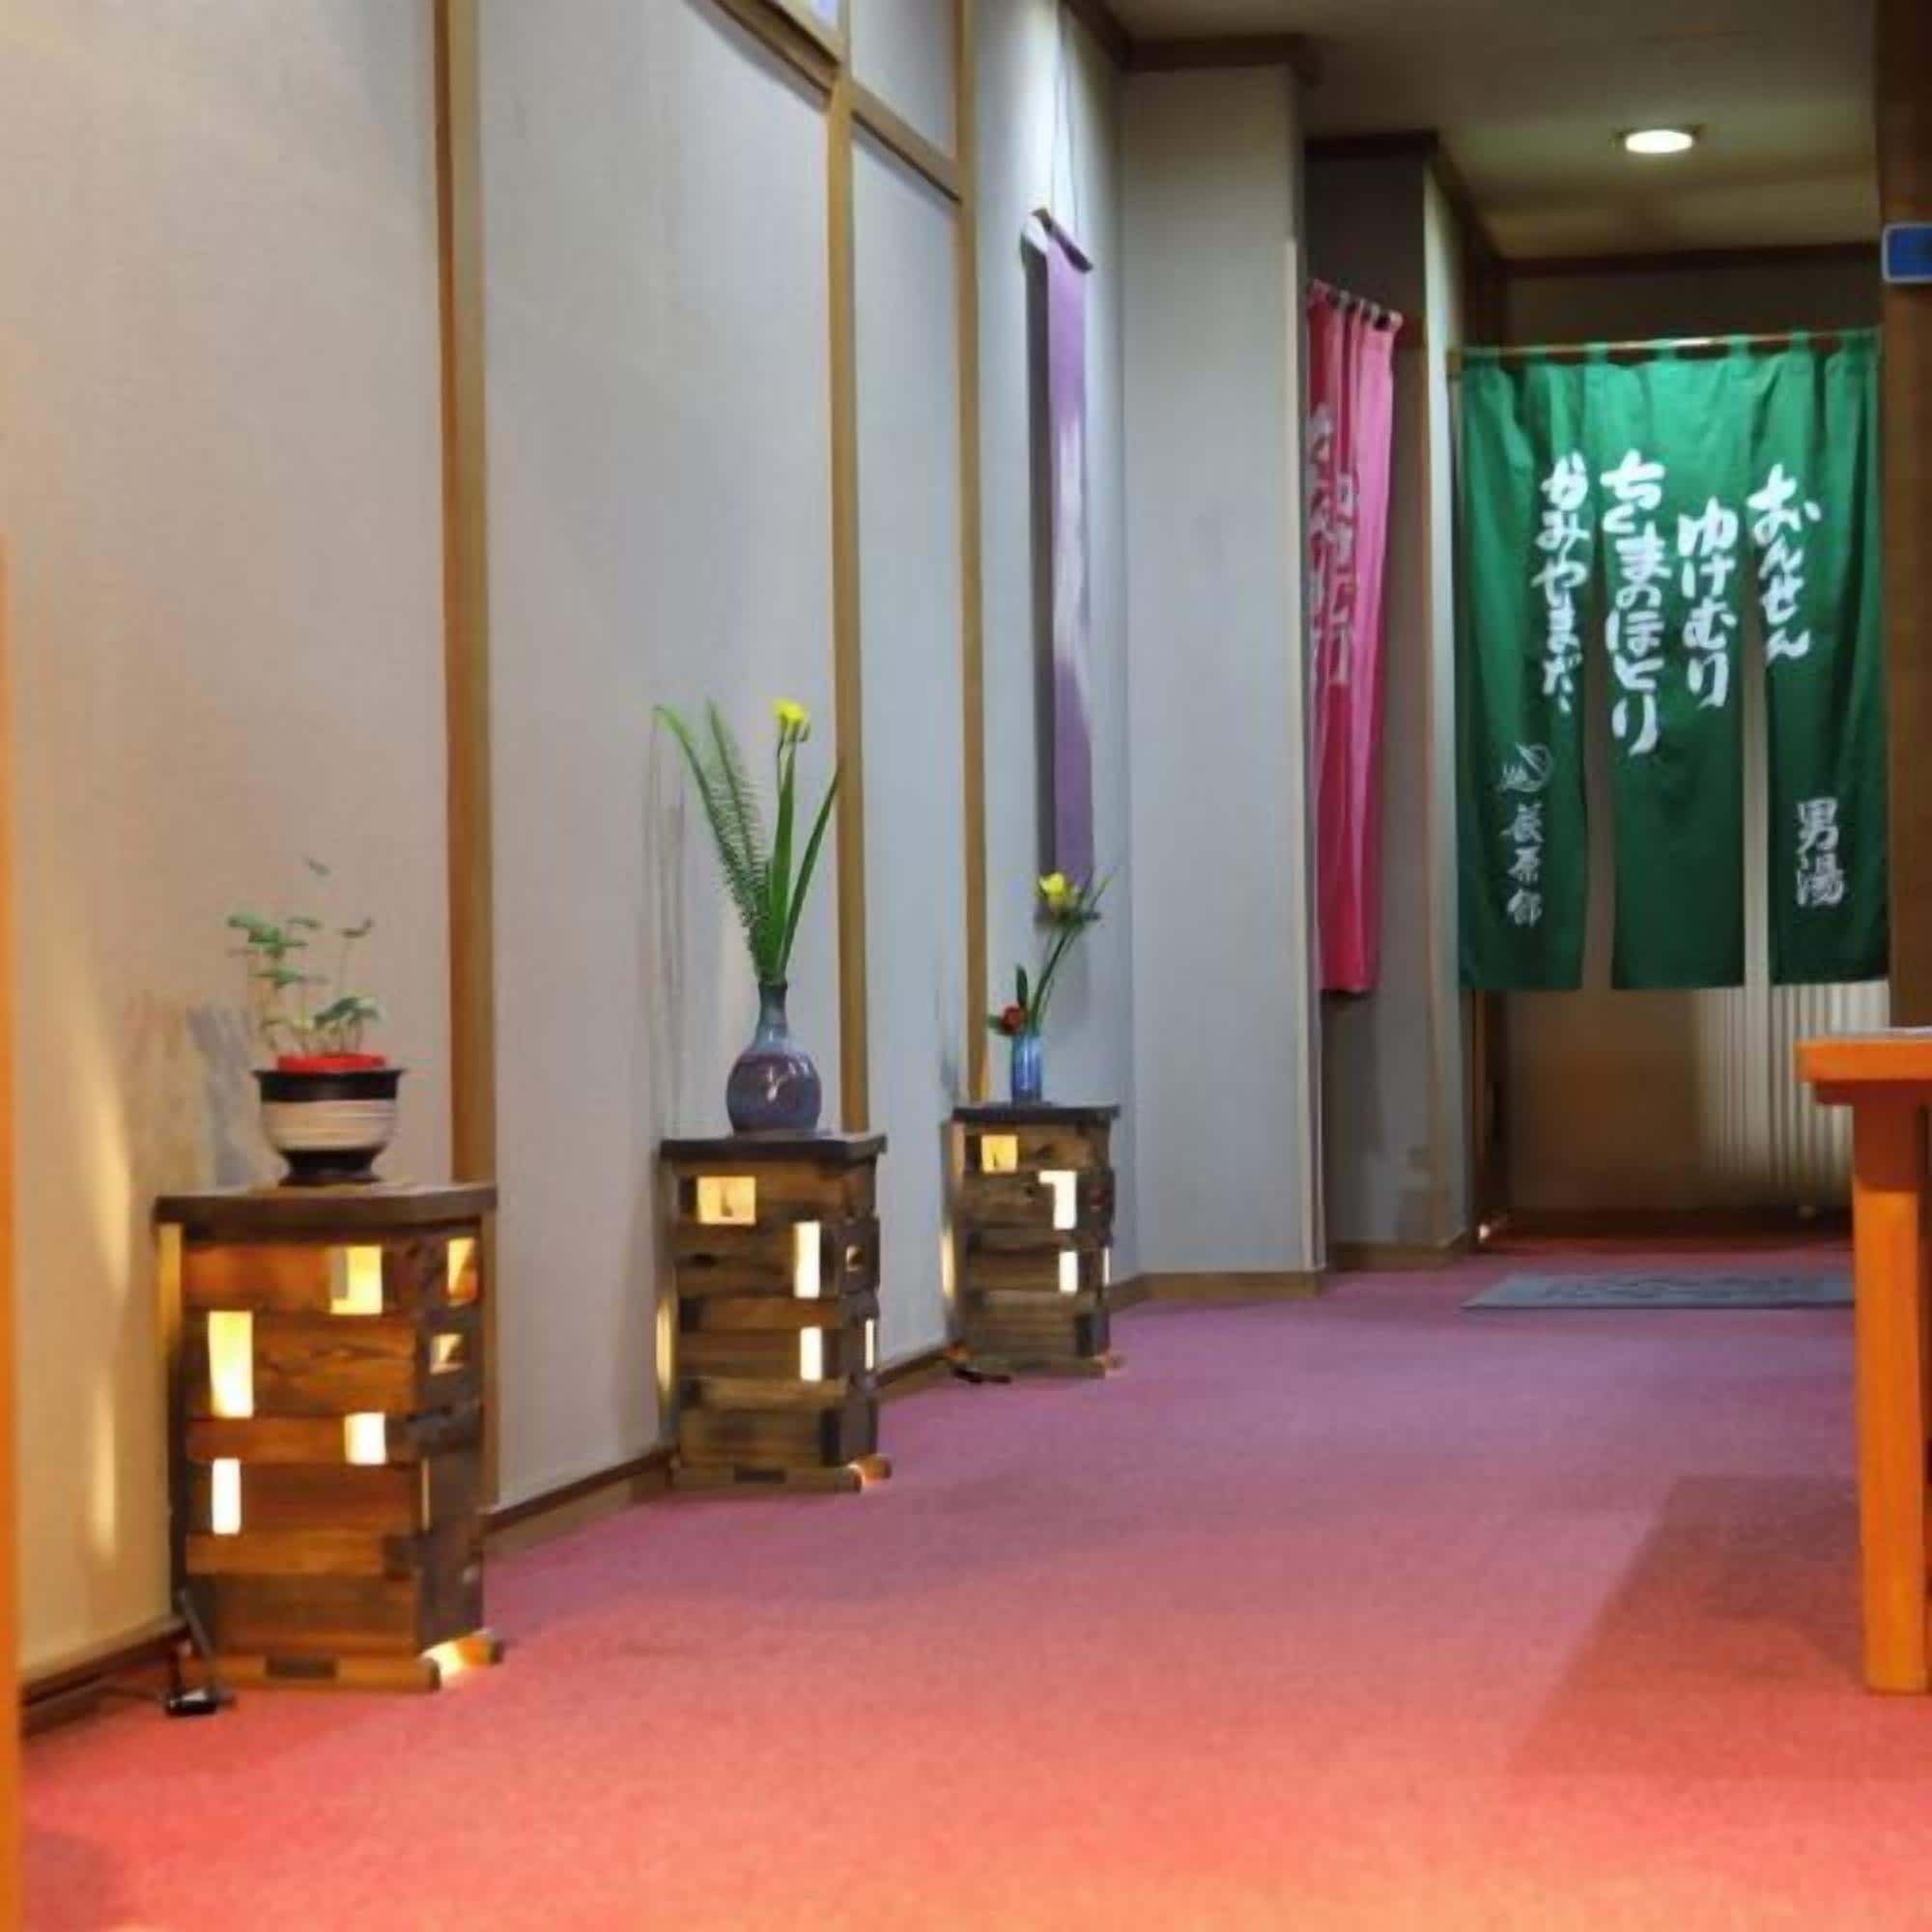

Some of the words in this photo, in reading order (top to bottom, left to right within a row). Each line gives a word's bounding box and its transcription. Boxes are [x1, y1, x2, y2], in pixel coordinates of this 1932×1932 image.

[1534, 450, 1589, 713] かみやまだ
[1600, 448, 1671, 754] ちくまのほとり
[1677, 496, 1739, 708] ゆけむり
[1747, 464, 1821, 661] おんせん
[1798, 797, 1844, 905] 男湯
